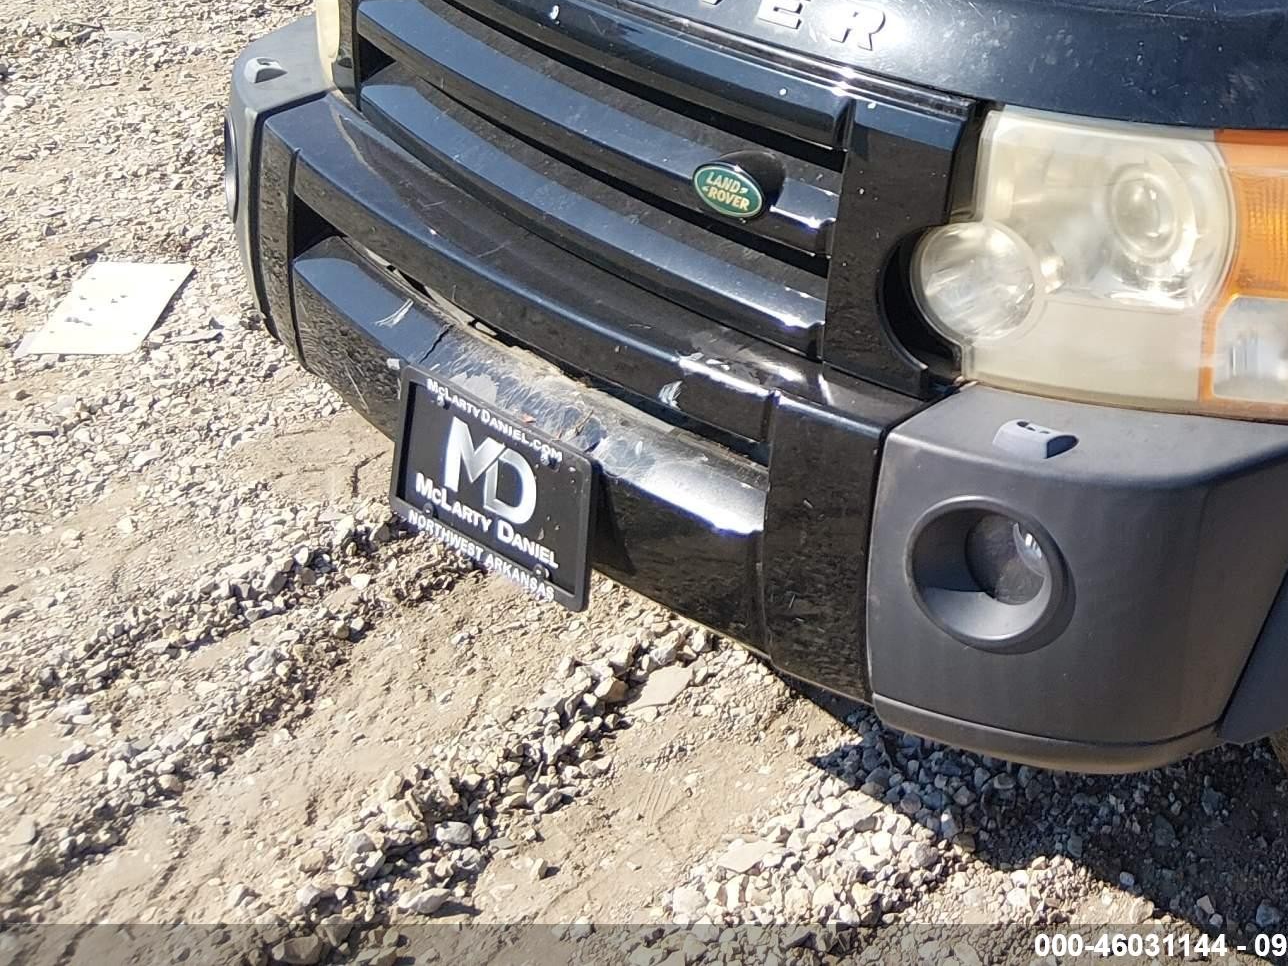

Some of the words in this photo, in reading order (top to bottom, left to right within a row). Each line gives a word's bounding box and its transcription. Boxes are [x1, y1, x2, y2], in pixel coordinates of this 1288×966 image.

[706, 171, 741, 194] LAND
[707, 186, 750, 211] ROVER
[443, 415, 537, 525] MD
[408, 509, 484, 562] NORTHWEST
[486, 553, 555, 603] ARKANSAS
[496, 518, 559, 569] DANIEL
